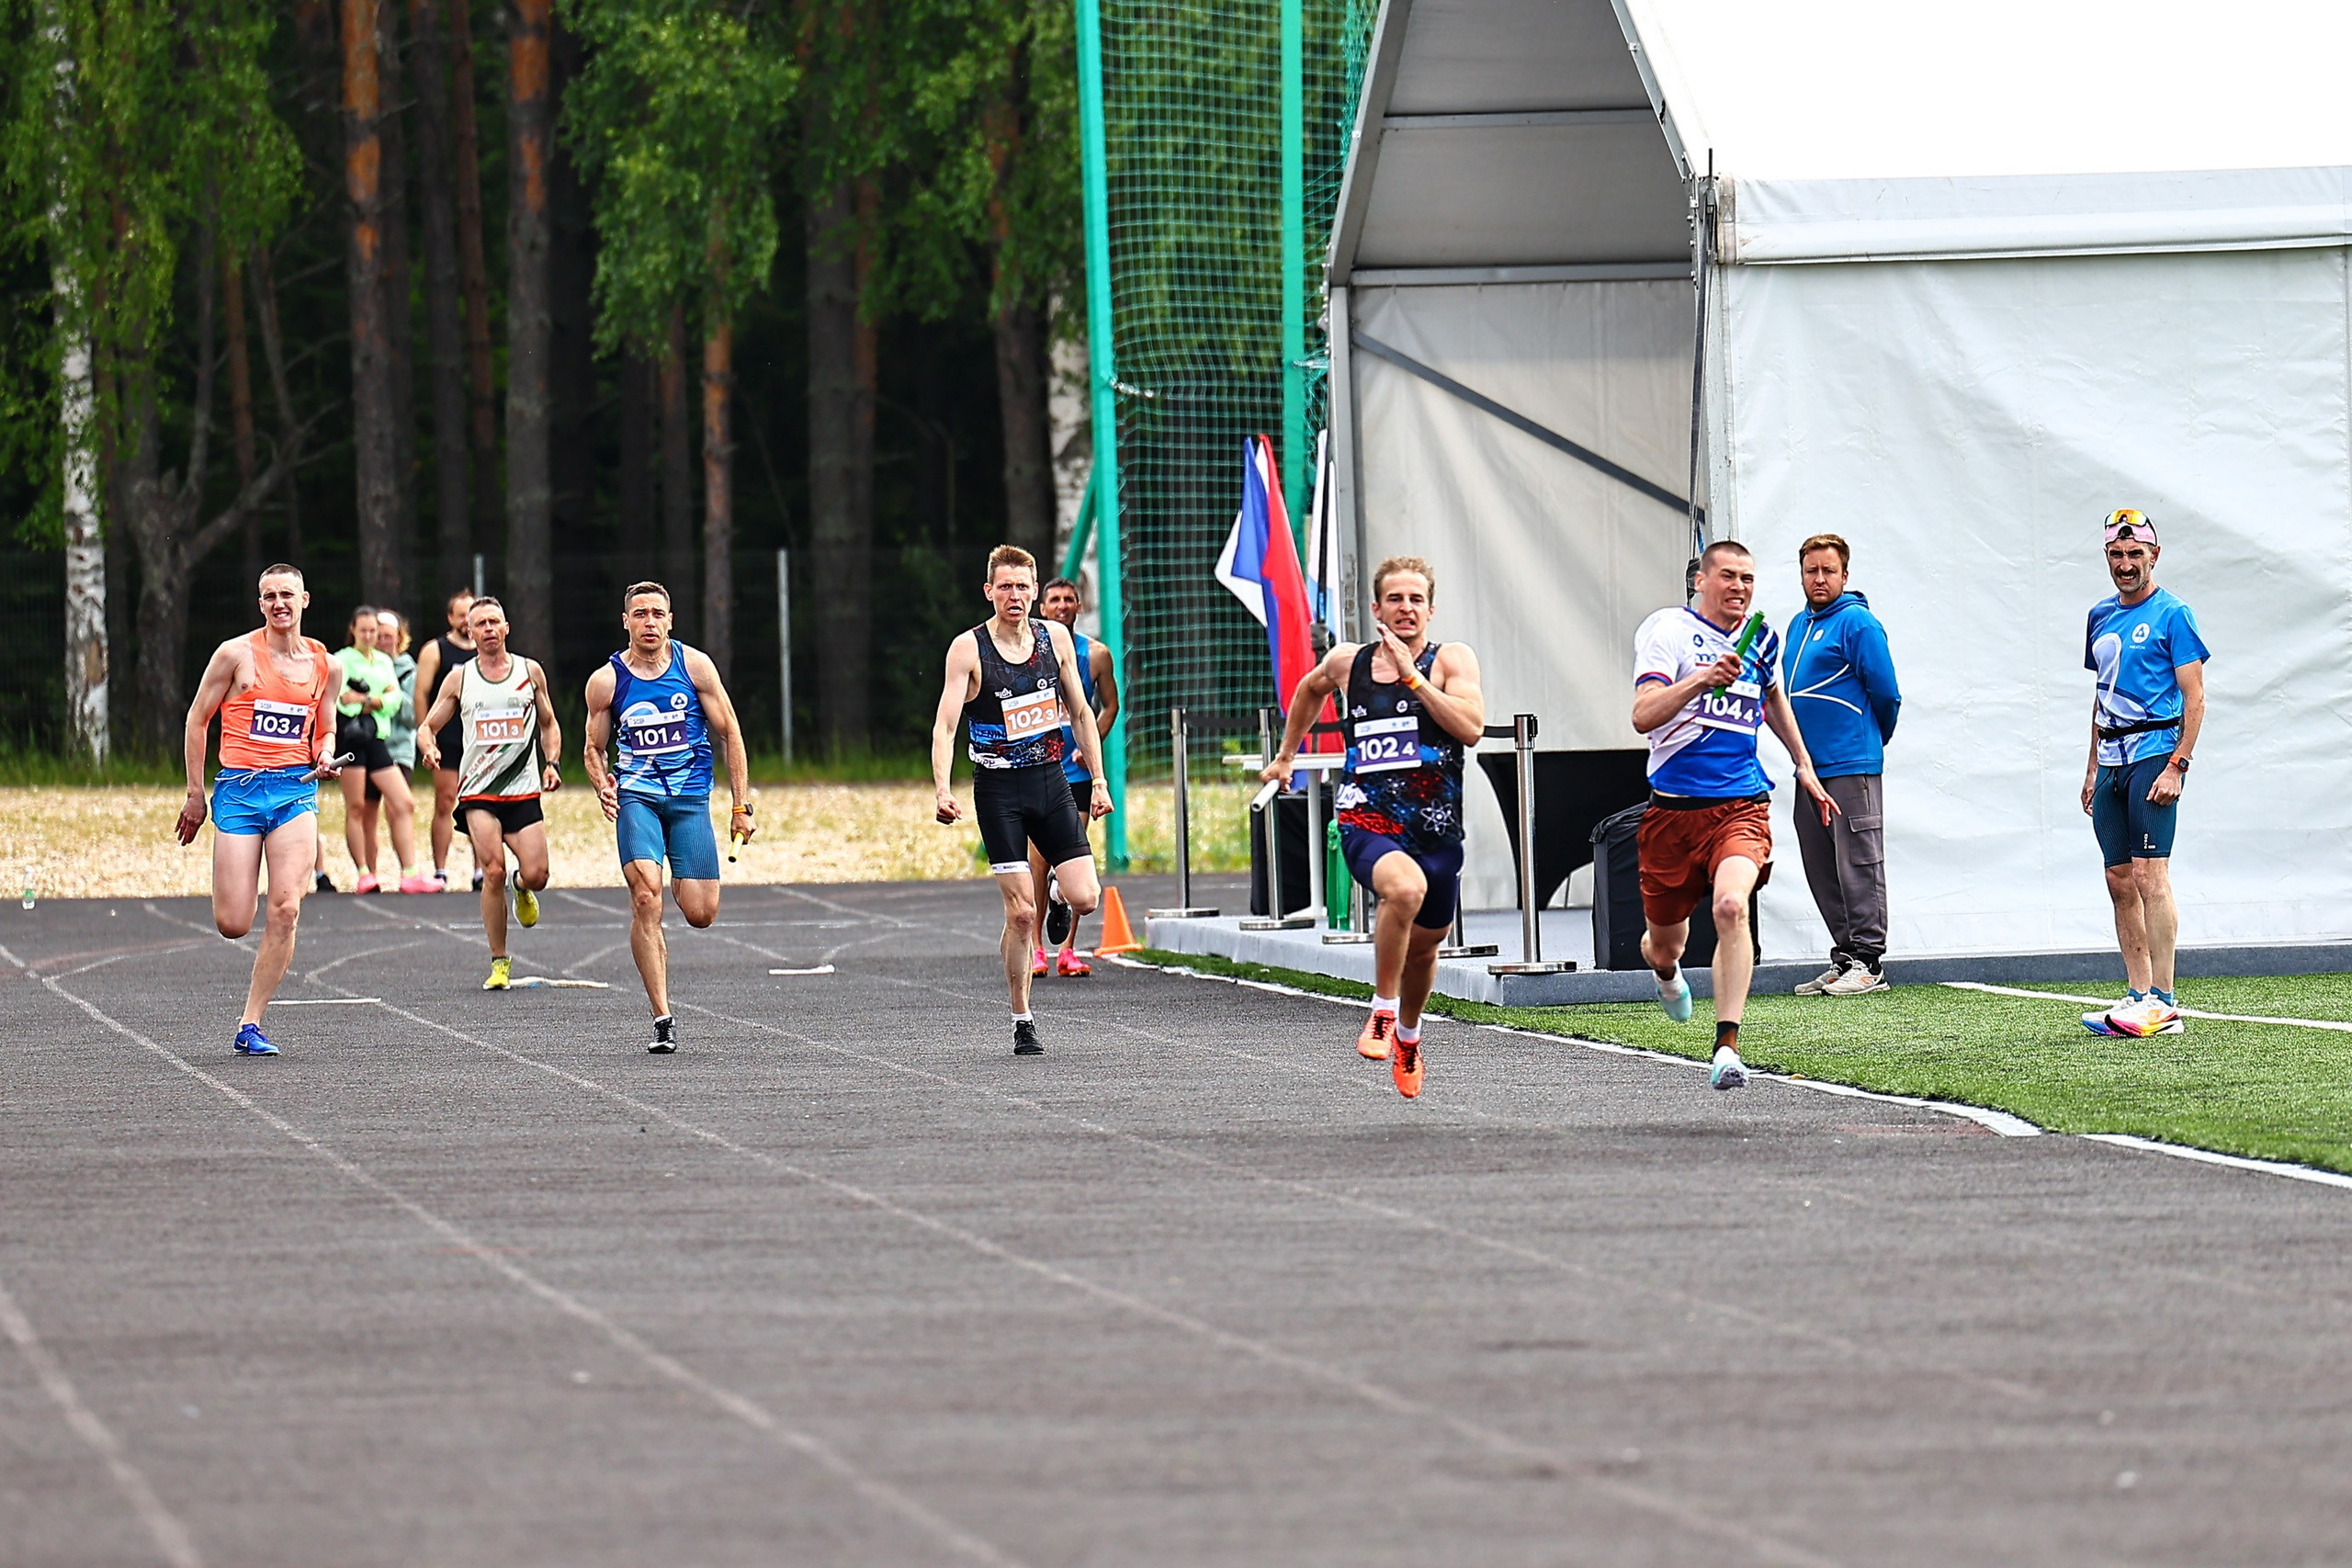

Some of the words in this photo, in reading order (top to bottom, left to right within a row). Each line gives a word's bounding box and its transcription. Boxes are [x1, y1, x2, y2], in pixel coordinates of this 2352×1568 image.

[1007, 706, 1045, 731] 102
[481, 721, 508, 739] 101
[634, 727, 668, 747] 101
[1357, 736, 1399, 761] 102
